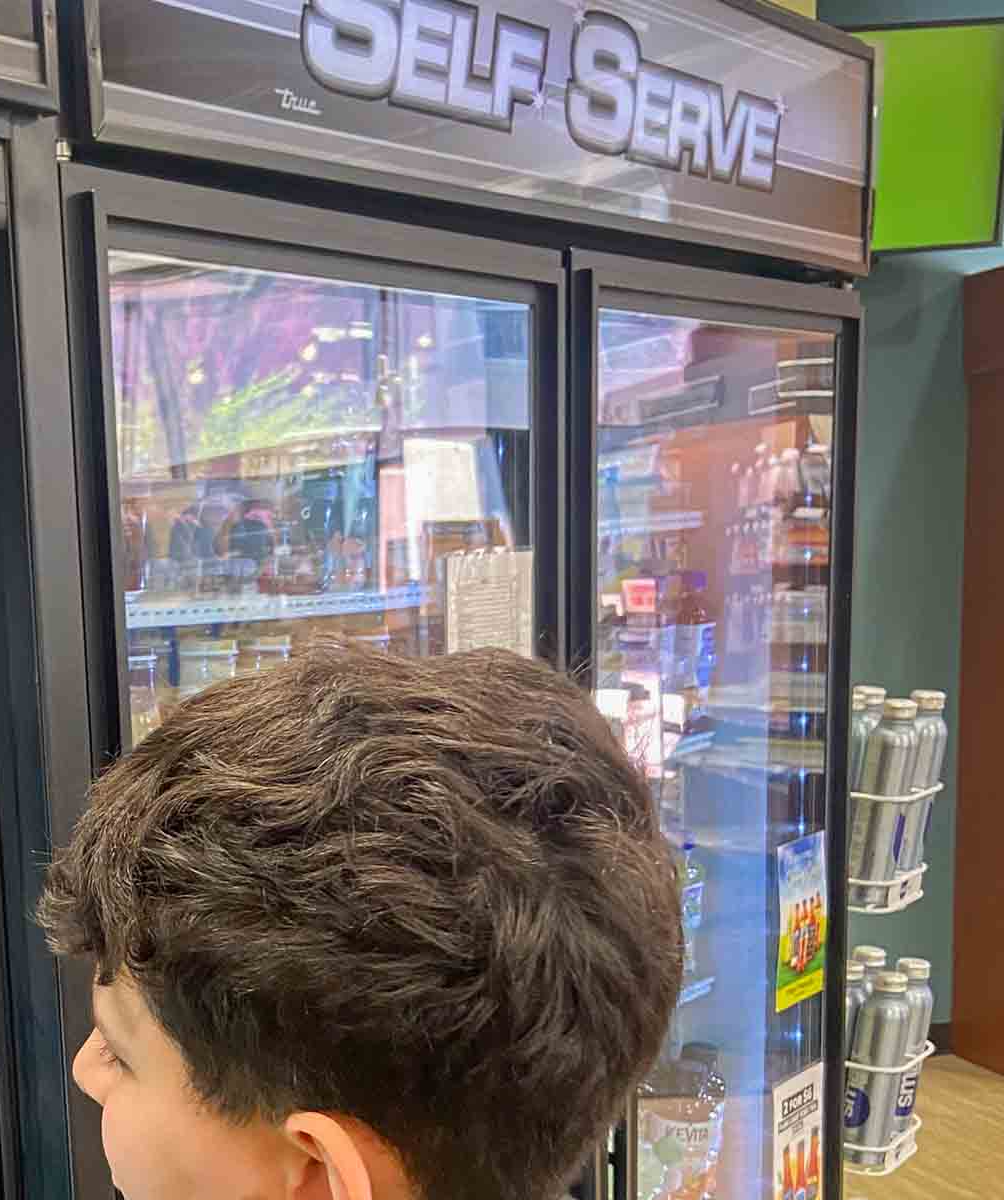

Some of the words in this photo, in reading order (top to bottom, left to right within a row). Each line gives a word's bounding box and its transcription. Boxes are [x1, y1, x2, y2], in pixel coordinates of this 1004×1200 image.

[275, 88, 322, 116] true
[300, 0, 550, 132] SELF
[565, 10, 783, 192] SERVE
